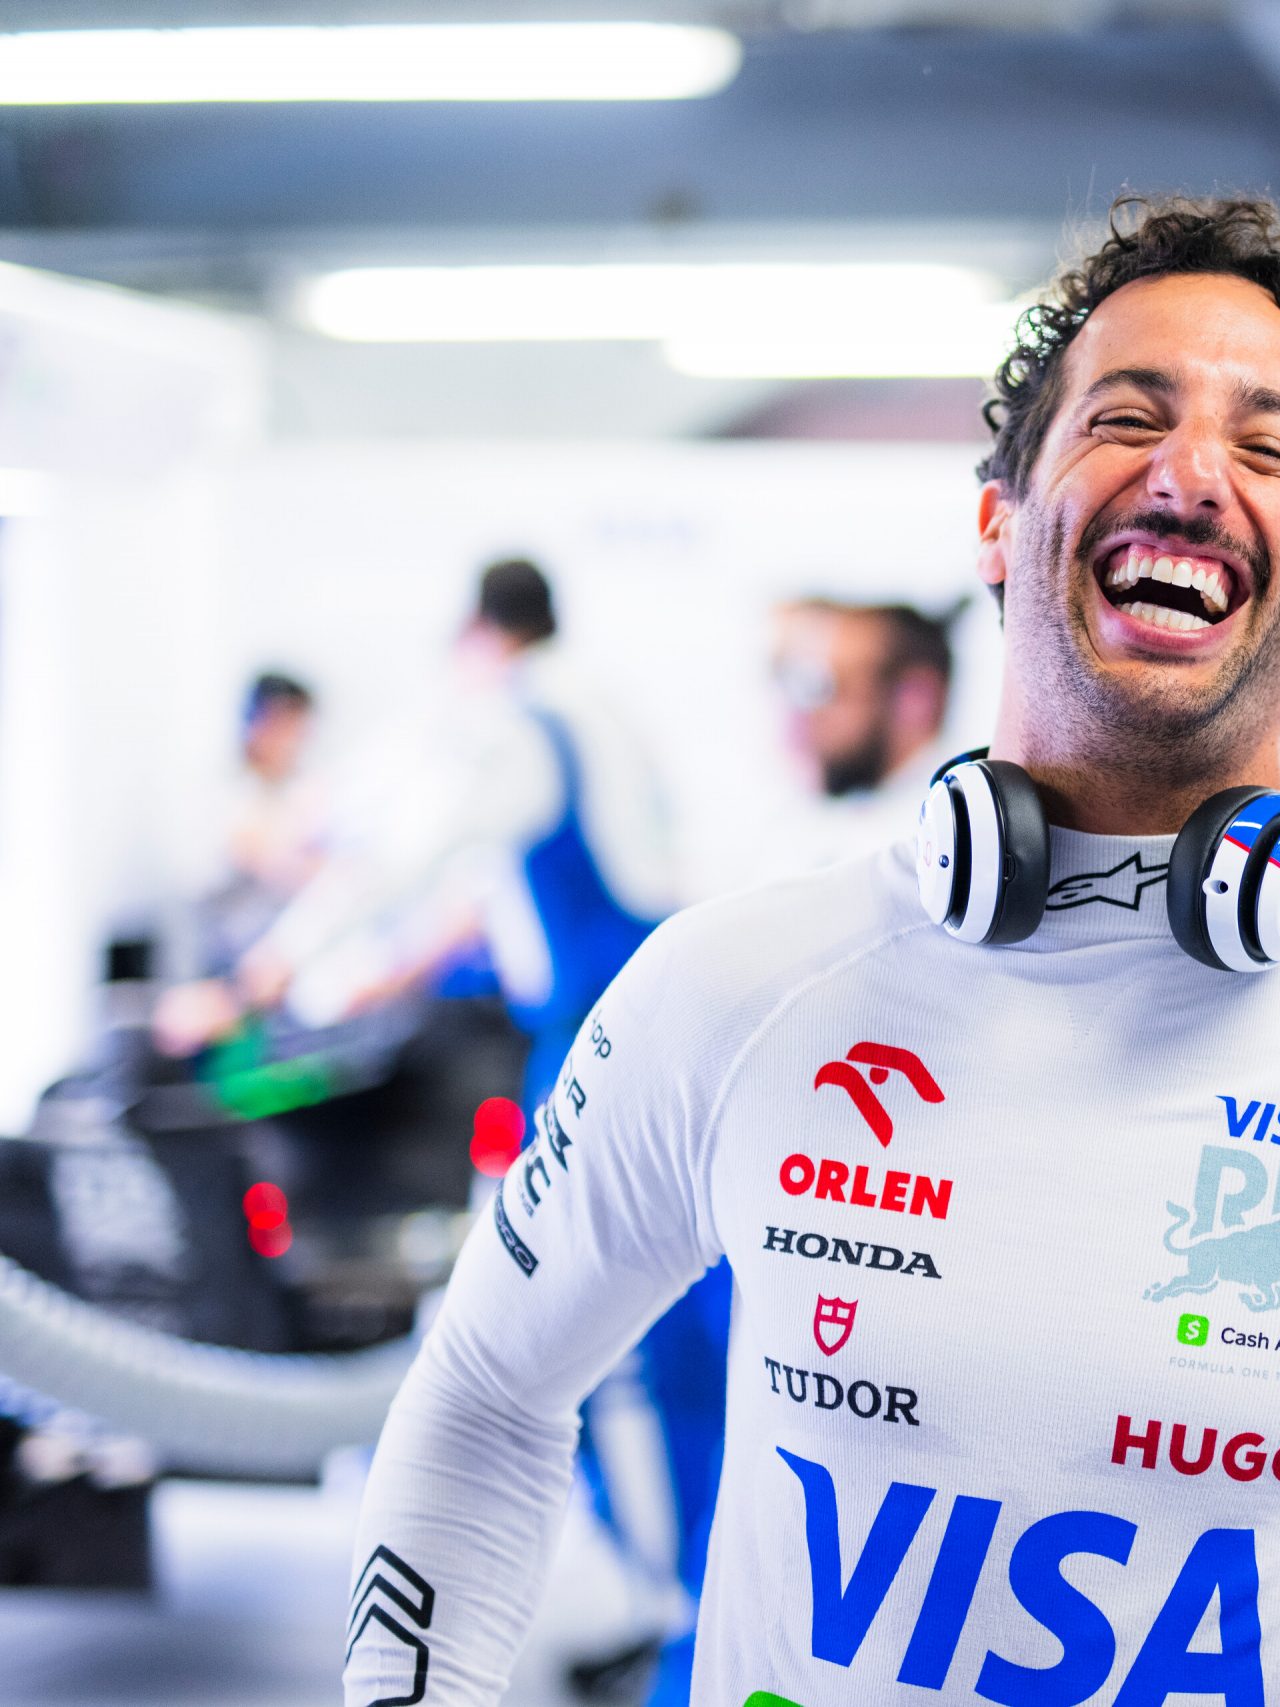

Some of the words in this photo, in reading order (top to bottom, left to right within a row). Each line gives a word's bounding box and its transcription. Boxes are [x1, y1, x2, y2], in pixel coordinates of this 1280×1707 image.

[779, 1153, 953, 1219] ORLEN
[762, 1226, 942, 1279] HONDA
[1169, 1356, 1235, 1375] FORMULA
[1241, 1367, 1269, 1380] ONE
[1220, 1327, 1270, 1350] Cash
[764, 1356, 920, 1426] TUDOR
[776, 1445, 1265, 1707] VISA
